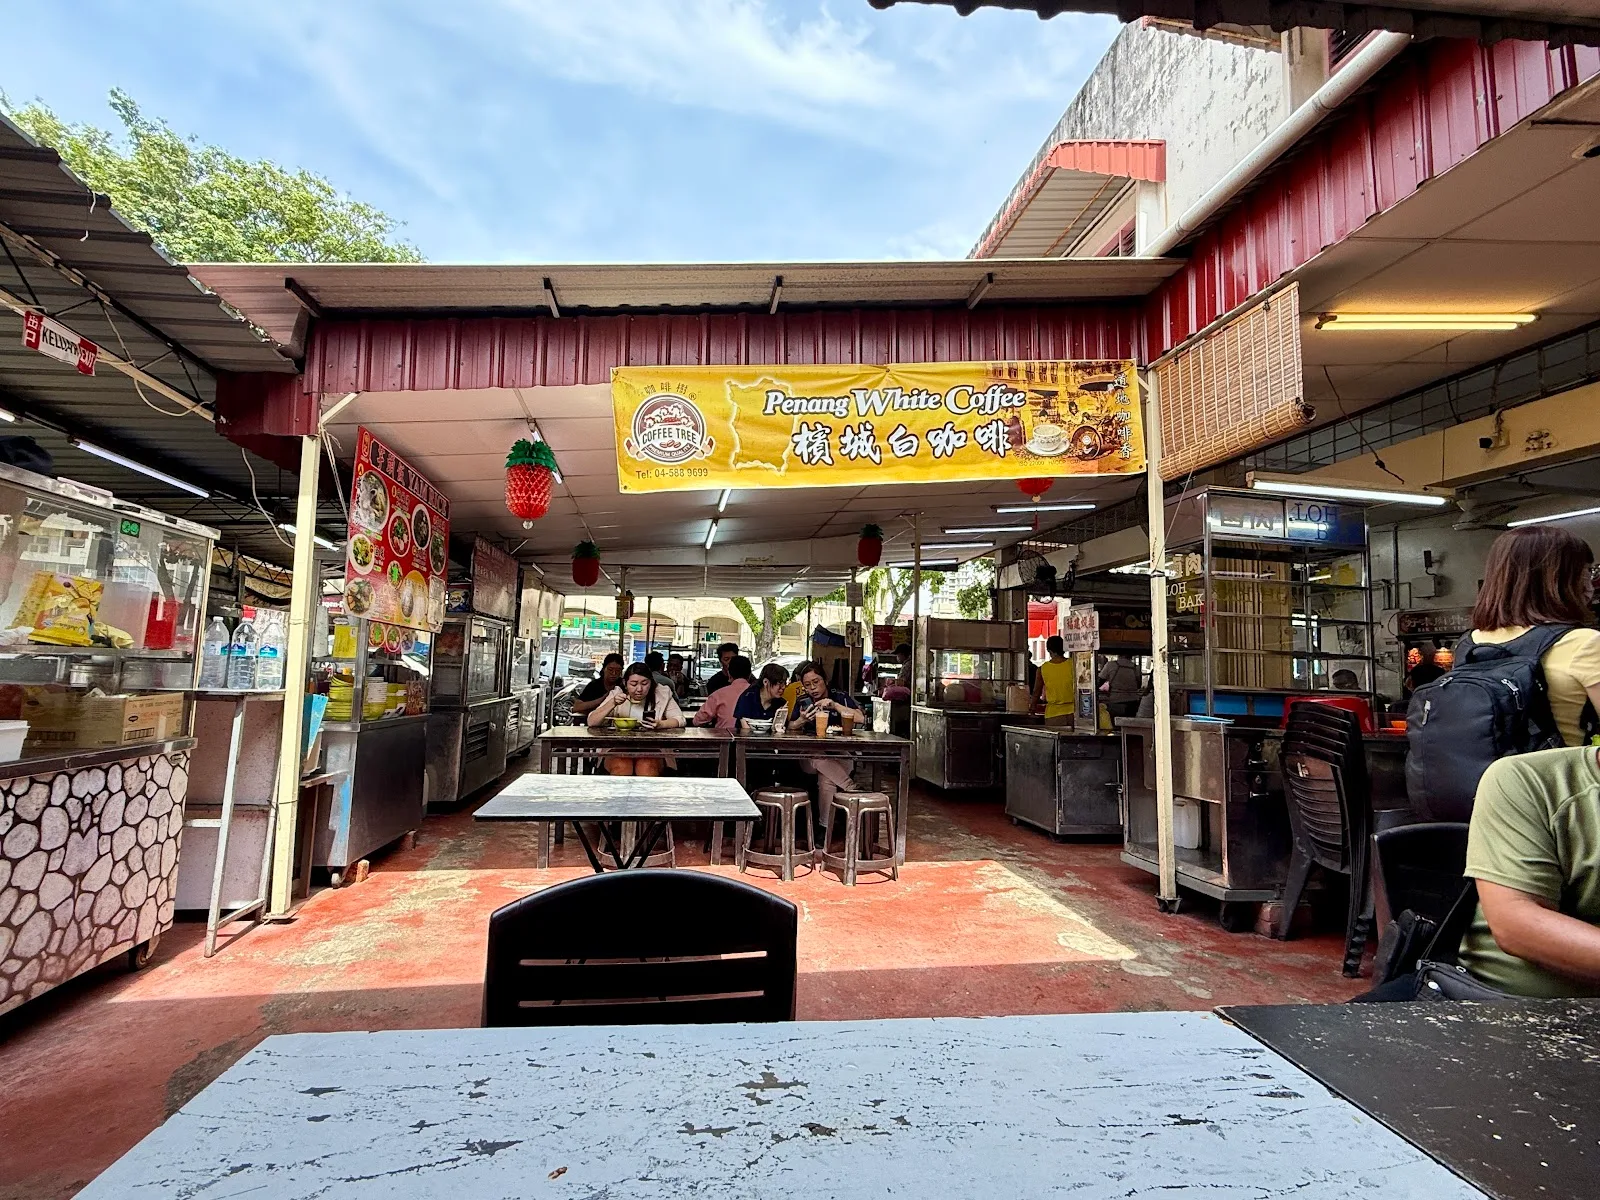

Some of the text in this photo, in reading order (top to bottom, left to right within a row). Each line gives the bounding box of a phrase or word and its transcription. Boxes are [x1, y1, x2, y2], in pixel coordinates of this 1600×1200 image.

[25, 315, 38, 343] 出口
[42, 326, 79, 357] KELUAR
[80, 347, 96, 368] EXIT
[763, 384, 1026, 418] Penang White Coffee
[1114, 373, 1132, 459] 道地咖啡香
[642, 427, 697, 445] COFFEE TREE
[791, 420, 1014, 466] 檳城白咖啡
[636, 467, 708, 479] Tel: 04-588 9699
[408, 469, 428, 502] YAM
[428, 487, 447, 518] RICE
[1294, 503, 1338, 524] LOH
[1166, 582, 1187, 597] LOH
[1178, 593, 1204, 609] BAK
